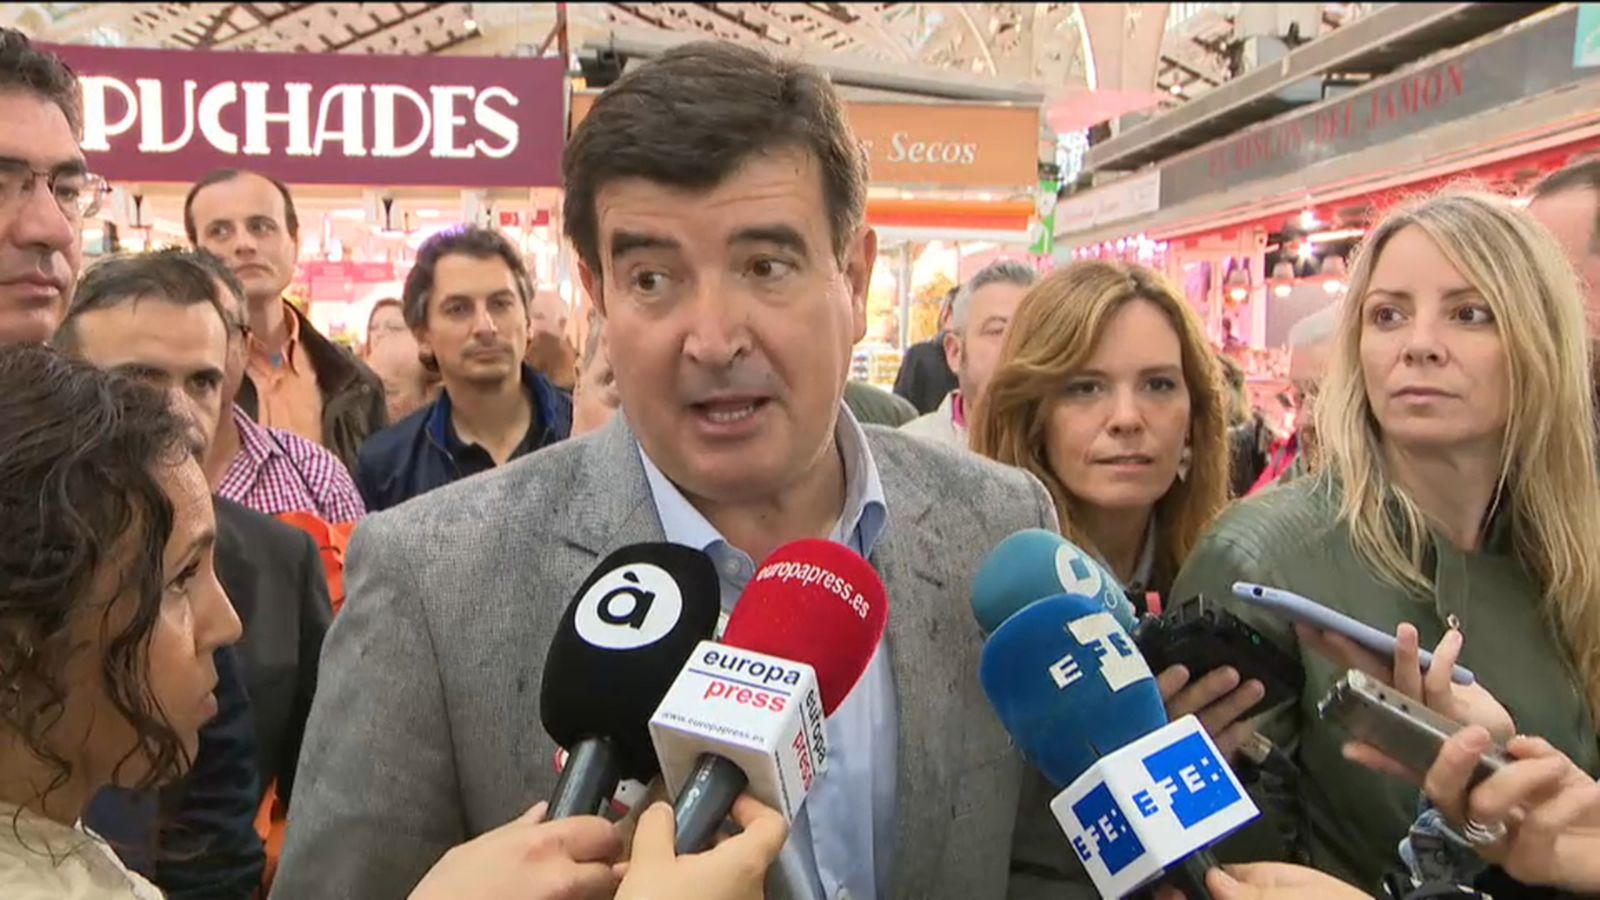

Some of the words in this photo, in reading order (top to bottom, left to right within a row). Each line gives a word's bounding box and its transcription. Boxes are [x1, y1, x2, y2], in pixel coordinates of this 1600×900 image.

[78, 76, 520, 159] PUCHADES
[886, 130, 977, 164] Secos
[756, 561, 870, 619] europapress.es
[703, 650, 801, 686] europa
[703, 680, 787, 713] press
[805, 688, 826, 765] europa
